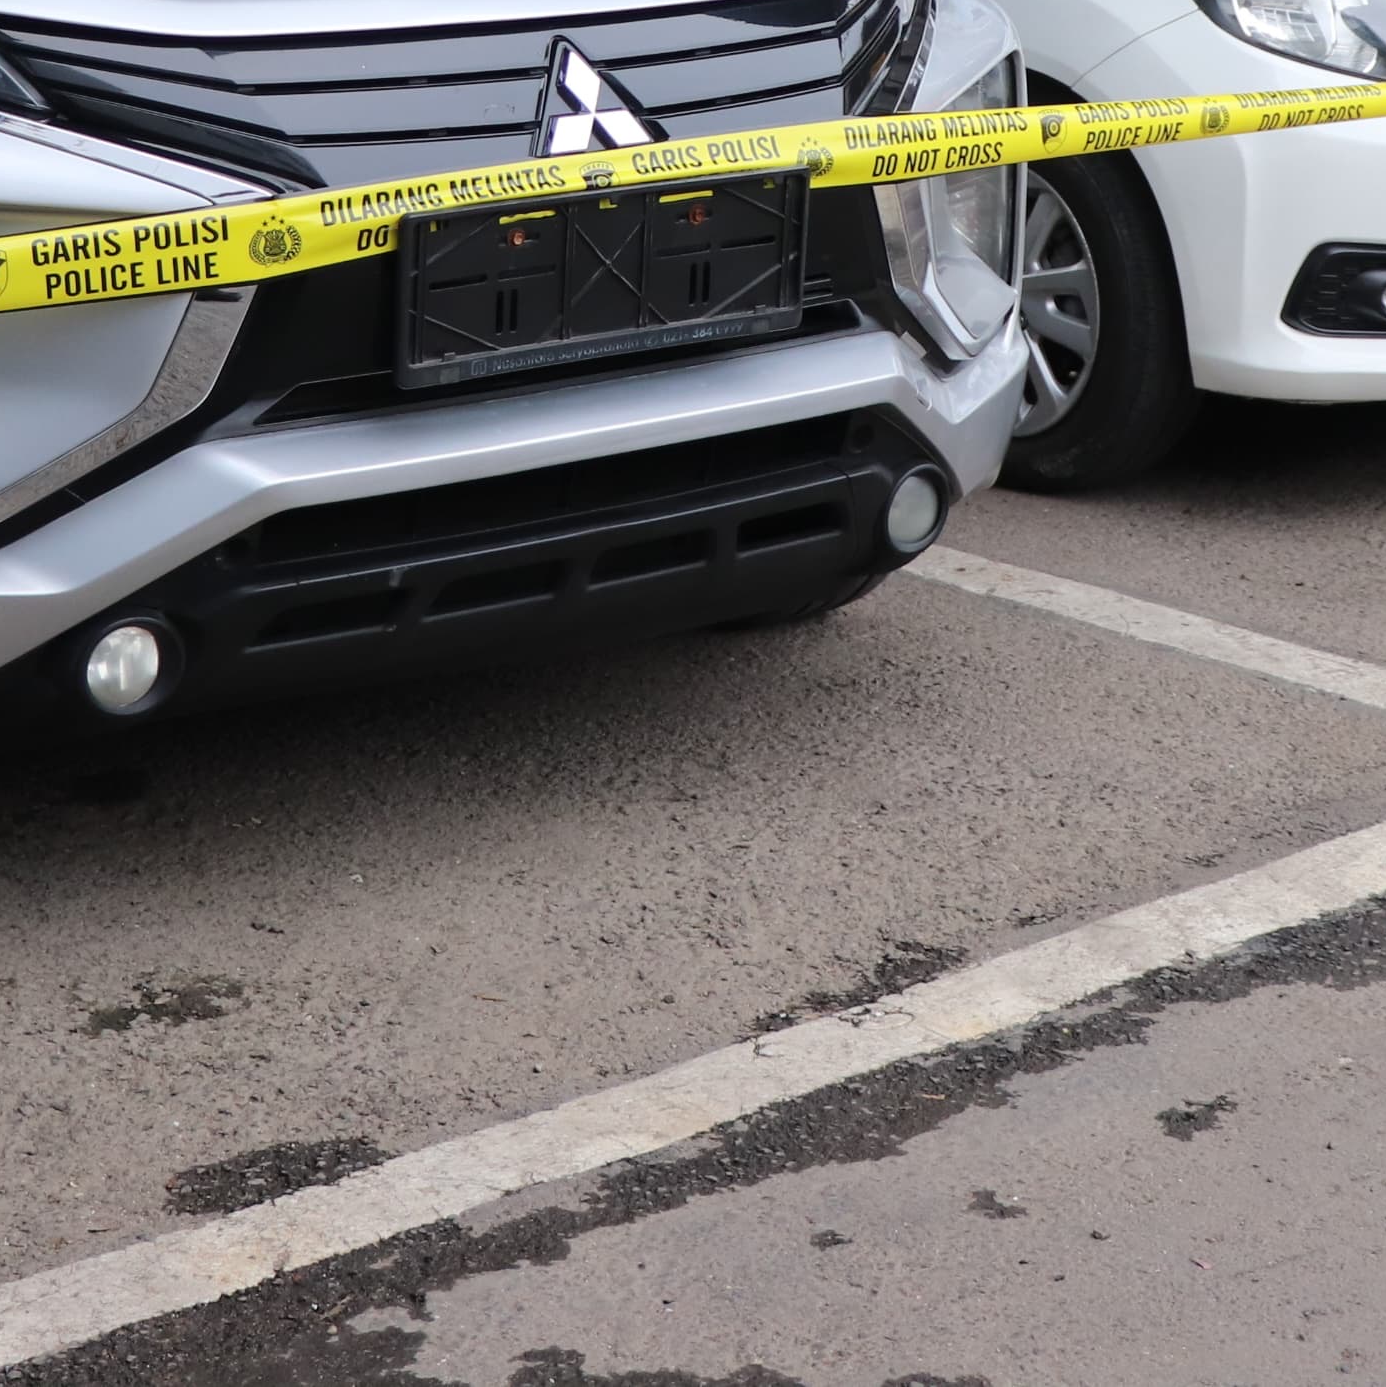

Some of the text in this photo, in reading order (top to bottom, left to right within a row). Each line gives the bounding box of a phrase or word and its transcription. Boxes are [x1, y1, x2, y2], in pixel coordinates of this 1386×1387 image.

[845, 110, 1029, 149] DILARANG MELINTAS
[1075, 96, 1190, 125] GARIS POLISI
[1284, 110, 1317, 128] NOT
[1319, 103, 1364, 123] CROSS
[632, 134, 781, 176] GARIS POLISI
[1083, 122, 1184, 151] POLICE LINE
[872, 141, 1003, 178] DO NOT CROSS
[319, 164, 567, 228] DILARANG MELINTAS
[30, 214, 231, 267] GARIS POLISI
[45, 251, 220, 300] POLICE LINE
